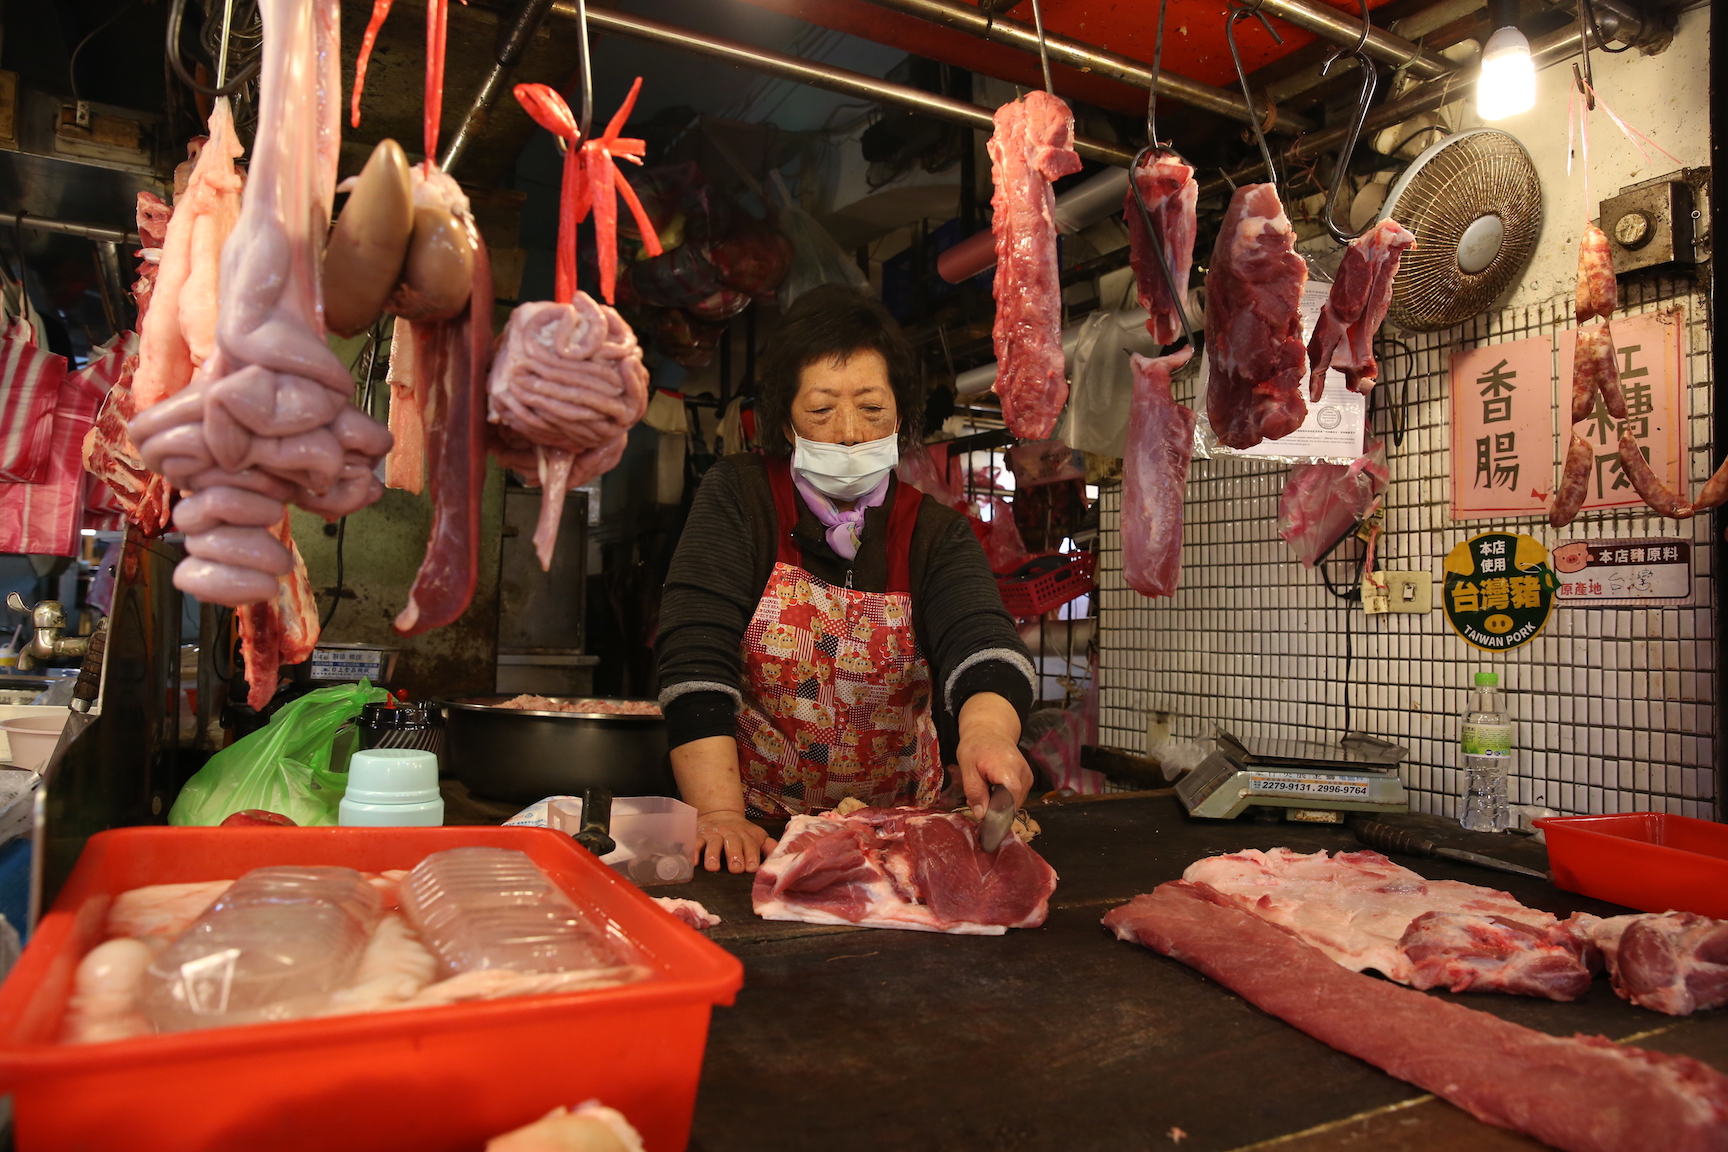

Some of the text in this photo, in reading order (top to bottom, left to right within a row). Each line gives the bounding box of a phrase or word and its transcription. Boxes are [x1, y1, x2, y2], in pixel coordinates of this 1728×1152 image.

[1474, 358, 1519, 492] 香腸
[1480, 540, 1506, 556] 本店
[1599, 546, 1678, 563] 本店豬原料
[1481, 558, 1506, 573] 使用
[1451, 575, 1541, 613] 台灣豬
[1560, 582, 1602, 596] 原產地
[1463, 621, 1536, 647] TAIWAN PORK
